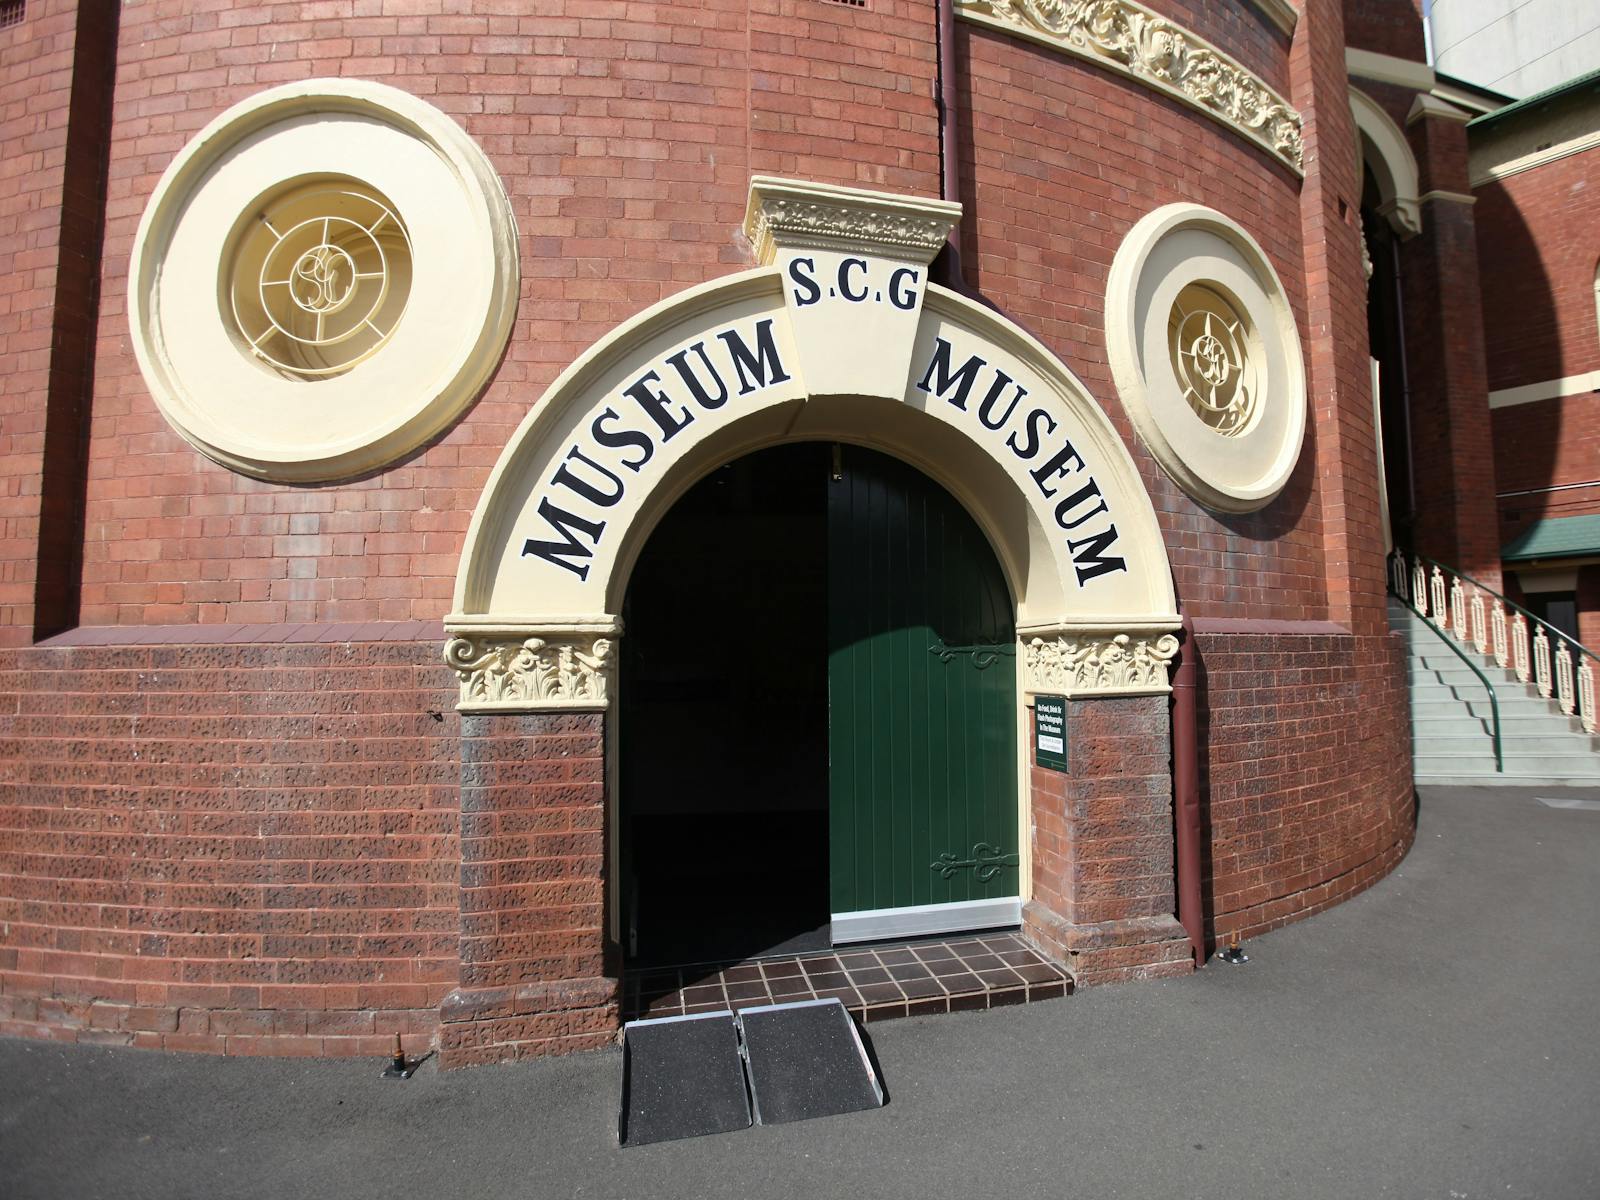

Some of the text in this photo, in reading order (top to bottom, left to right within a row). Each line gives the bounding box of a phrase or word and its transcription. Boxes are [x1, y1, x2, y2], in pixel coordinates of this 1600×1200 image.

[788, 256, 920, 311] S.C.G
[521, 318, 791, 582] MUSEUM
[916, 336, 1127, 588] MUSEUM
[1045, 714, 1063, 726] Photography
